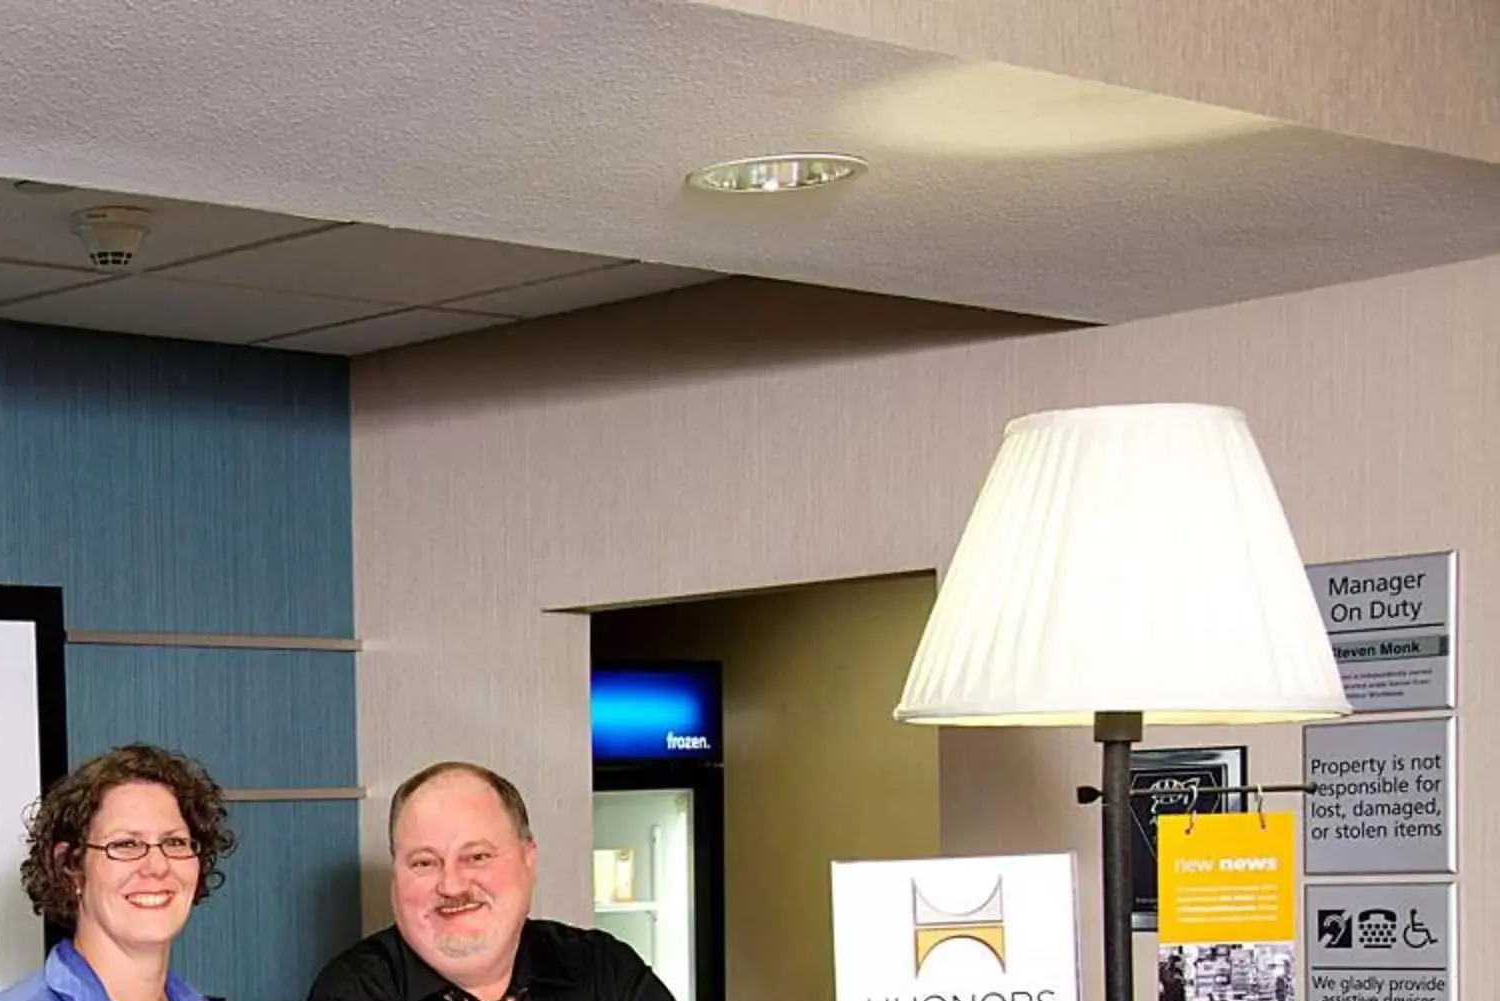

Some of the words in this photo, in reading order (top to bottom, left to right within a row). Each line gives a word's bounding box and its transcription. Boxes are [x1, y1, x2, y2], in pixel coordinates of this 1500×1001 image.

[1328, 573, 1426, 596] Manager
[1331, 603, 1362, 623] On
[1370, 600, 1422, 621] Duty
[1380, 641, 1420, 655] Monk
[666, 731, 711, 749] frozen.
[1311, 758, 1386, 777] Property
[1393, 754, 1405, 771] is
[1411, 755, 1441, 771] not
[1415, 774, 1441, 792] for
[1311, 802, 1346, 819] lost,
[1353, 797, 1441, 820] damaged,
[1311, 827, 1328, 839] or
[1335, 822, 1387, 839] stolen
[1394, 821, 1443, 838] items
[1174, 857, 1213, 873] new
[1219, 857, 1278, 871] news
[1311, 976, 1336, 990] We
[1341, 976, 1383, 994] gladly
[1389, 976, 1445, 995] provide
